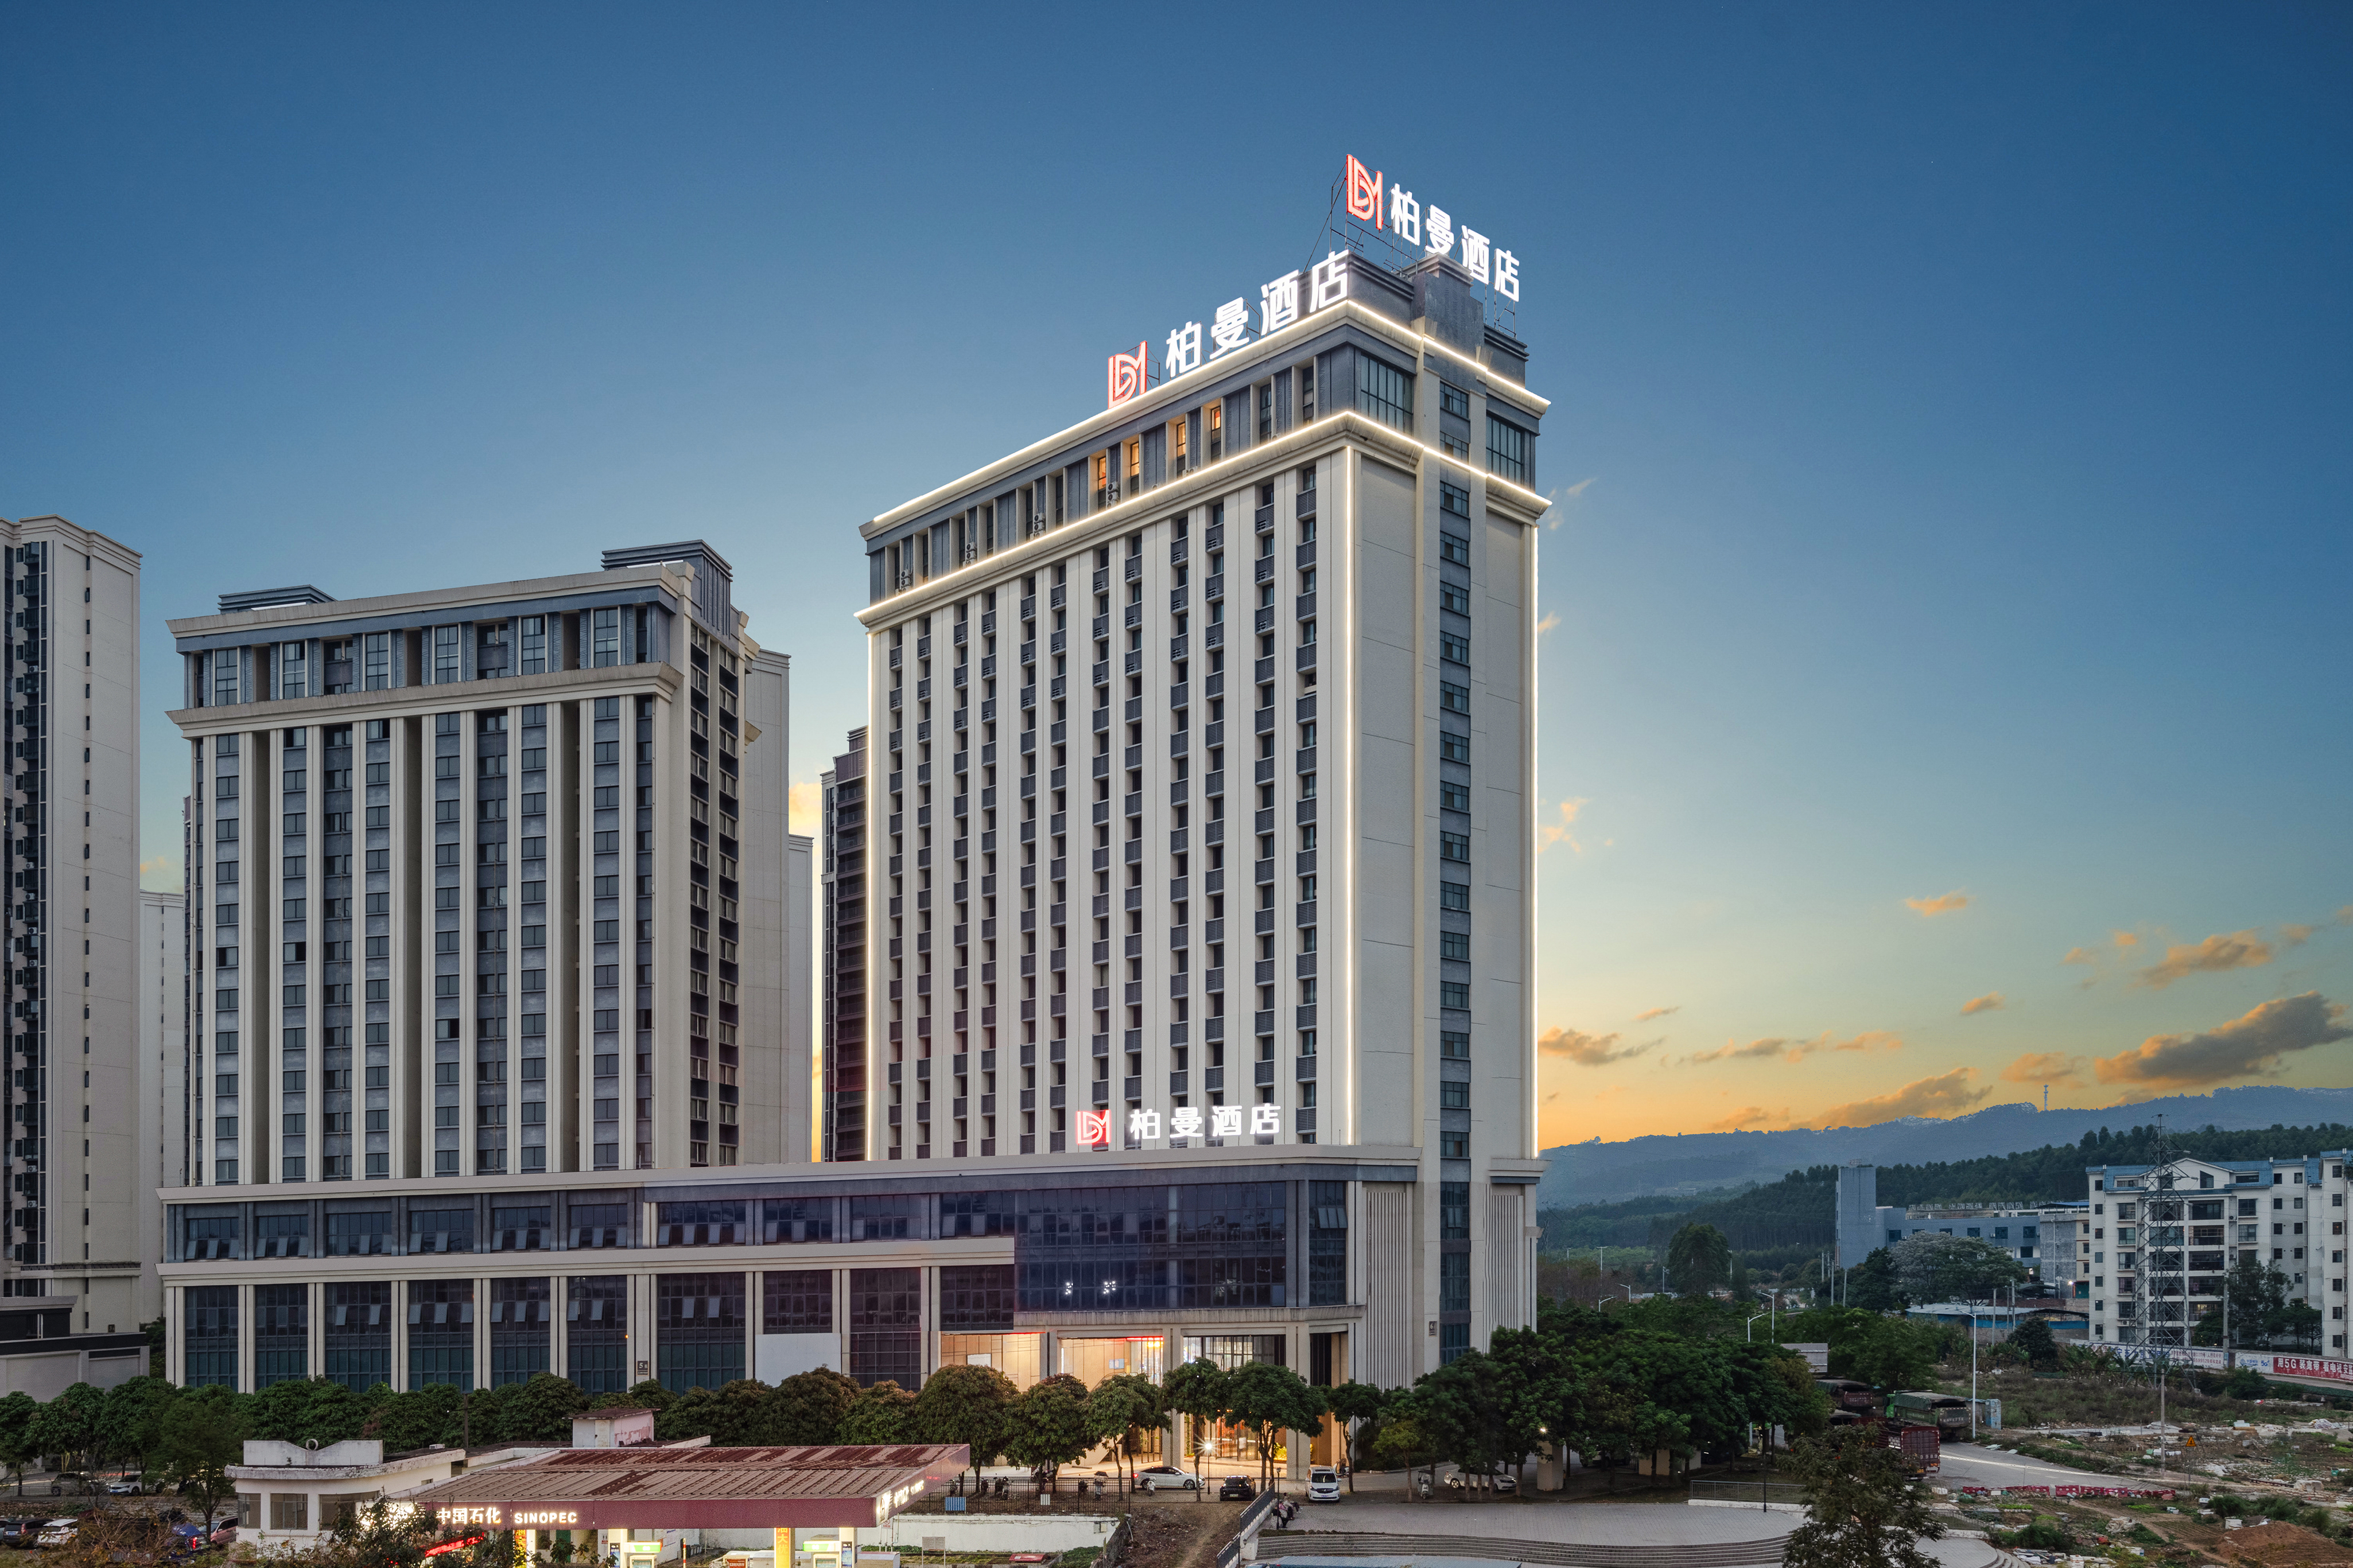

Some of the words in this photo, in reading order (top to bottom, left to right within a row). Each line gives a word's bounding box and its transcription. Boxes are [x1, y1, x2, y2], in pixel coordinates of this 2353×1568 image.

[1390, 183, 1520, 302] 柏曼酒店
[1166, 250, 1349, 378] 柏曼酒店
[1130, 1103, 1281, 1139] 柏曼酒店
[436, 1507, 502, 1524] 中国石化
[514, 1512, 577, 1524] SINOPEC
